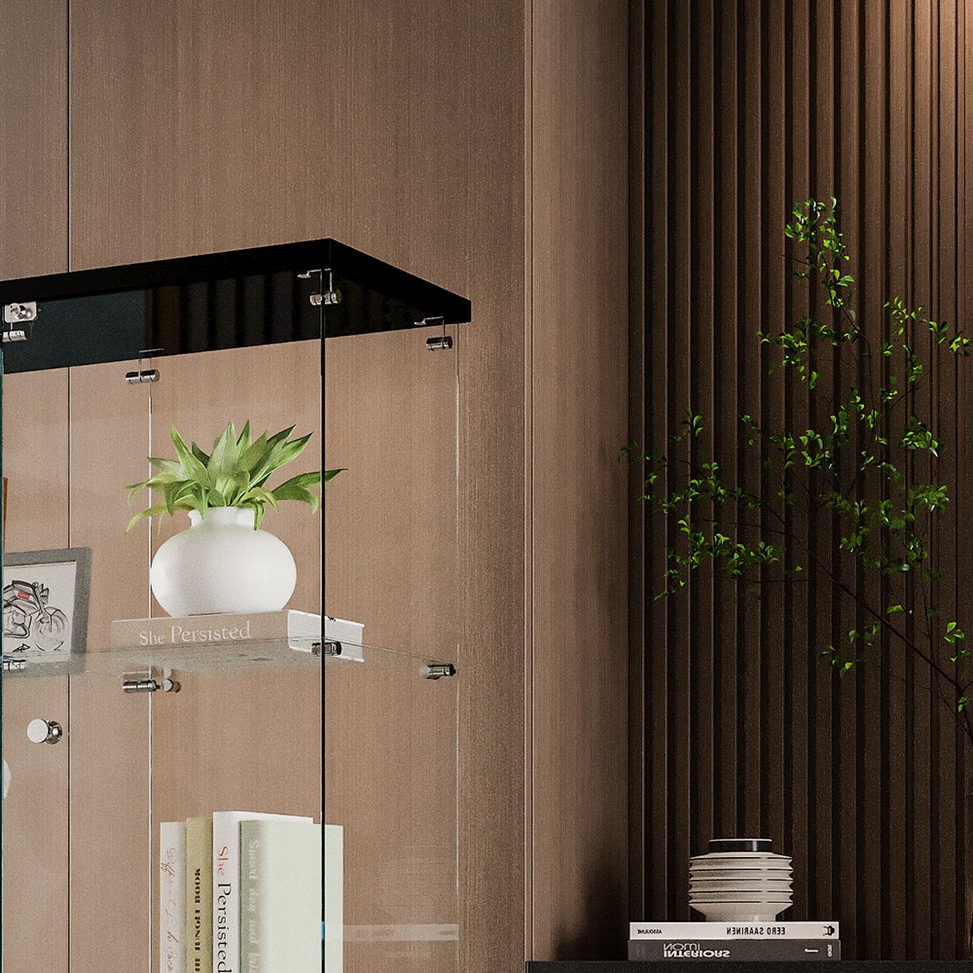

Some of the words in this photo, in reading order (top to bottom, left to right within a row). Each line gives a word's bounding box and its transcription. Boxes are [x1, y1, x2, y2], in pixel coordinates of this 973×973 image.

[139, 630, 165, 646] She
[170, 621, 251, 643] Persisted
[217, 846, 229, 876] She
[193, 867, 201, 904] BOOK
[217, 883, 232, 973] Persisted
